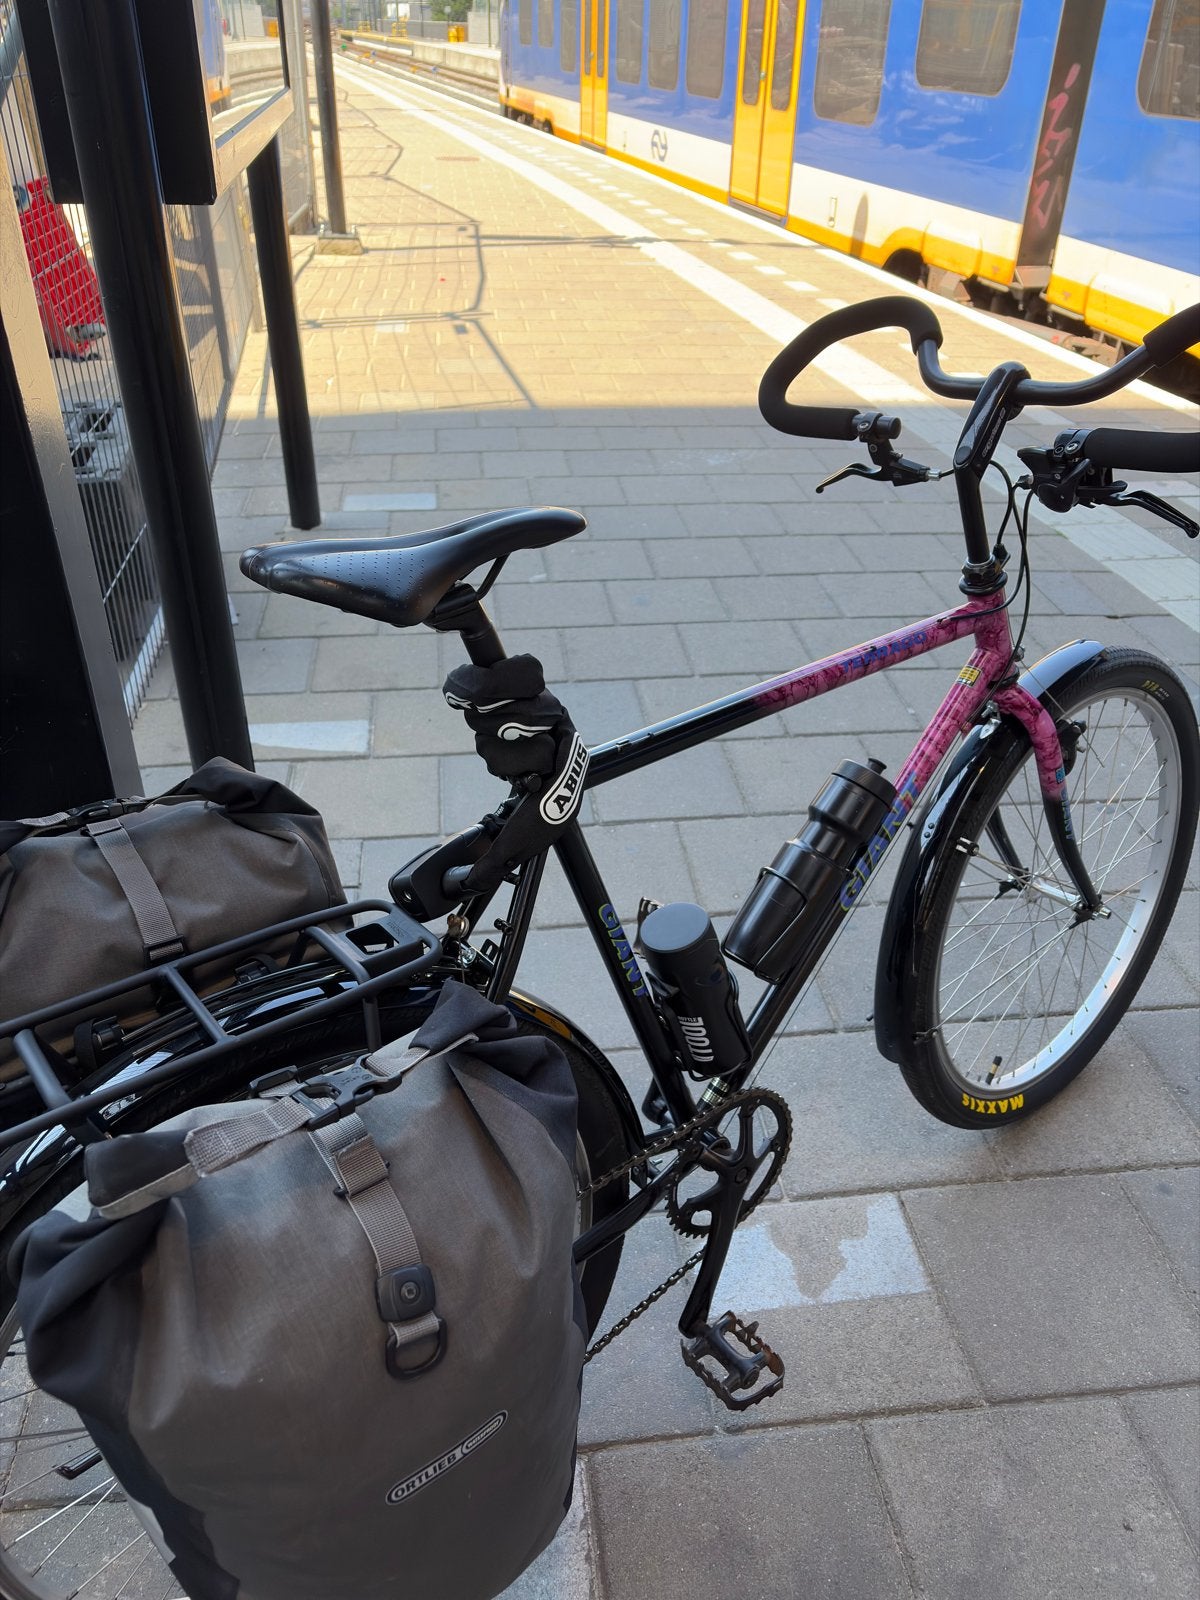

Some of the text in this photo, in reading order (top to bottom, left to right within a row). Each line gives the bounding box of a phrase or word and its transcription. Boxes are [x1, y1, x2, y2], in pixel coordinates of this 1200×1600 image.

[552, 743, 588, 814] ABUS
[839, 770, 920, 911] GIANT
[598, 903, 649, 998] GIANT
[962, 1093, 1024, 1114] MAXXIS
[394, 1452, 457, 1499] ORTLIEB
